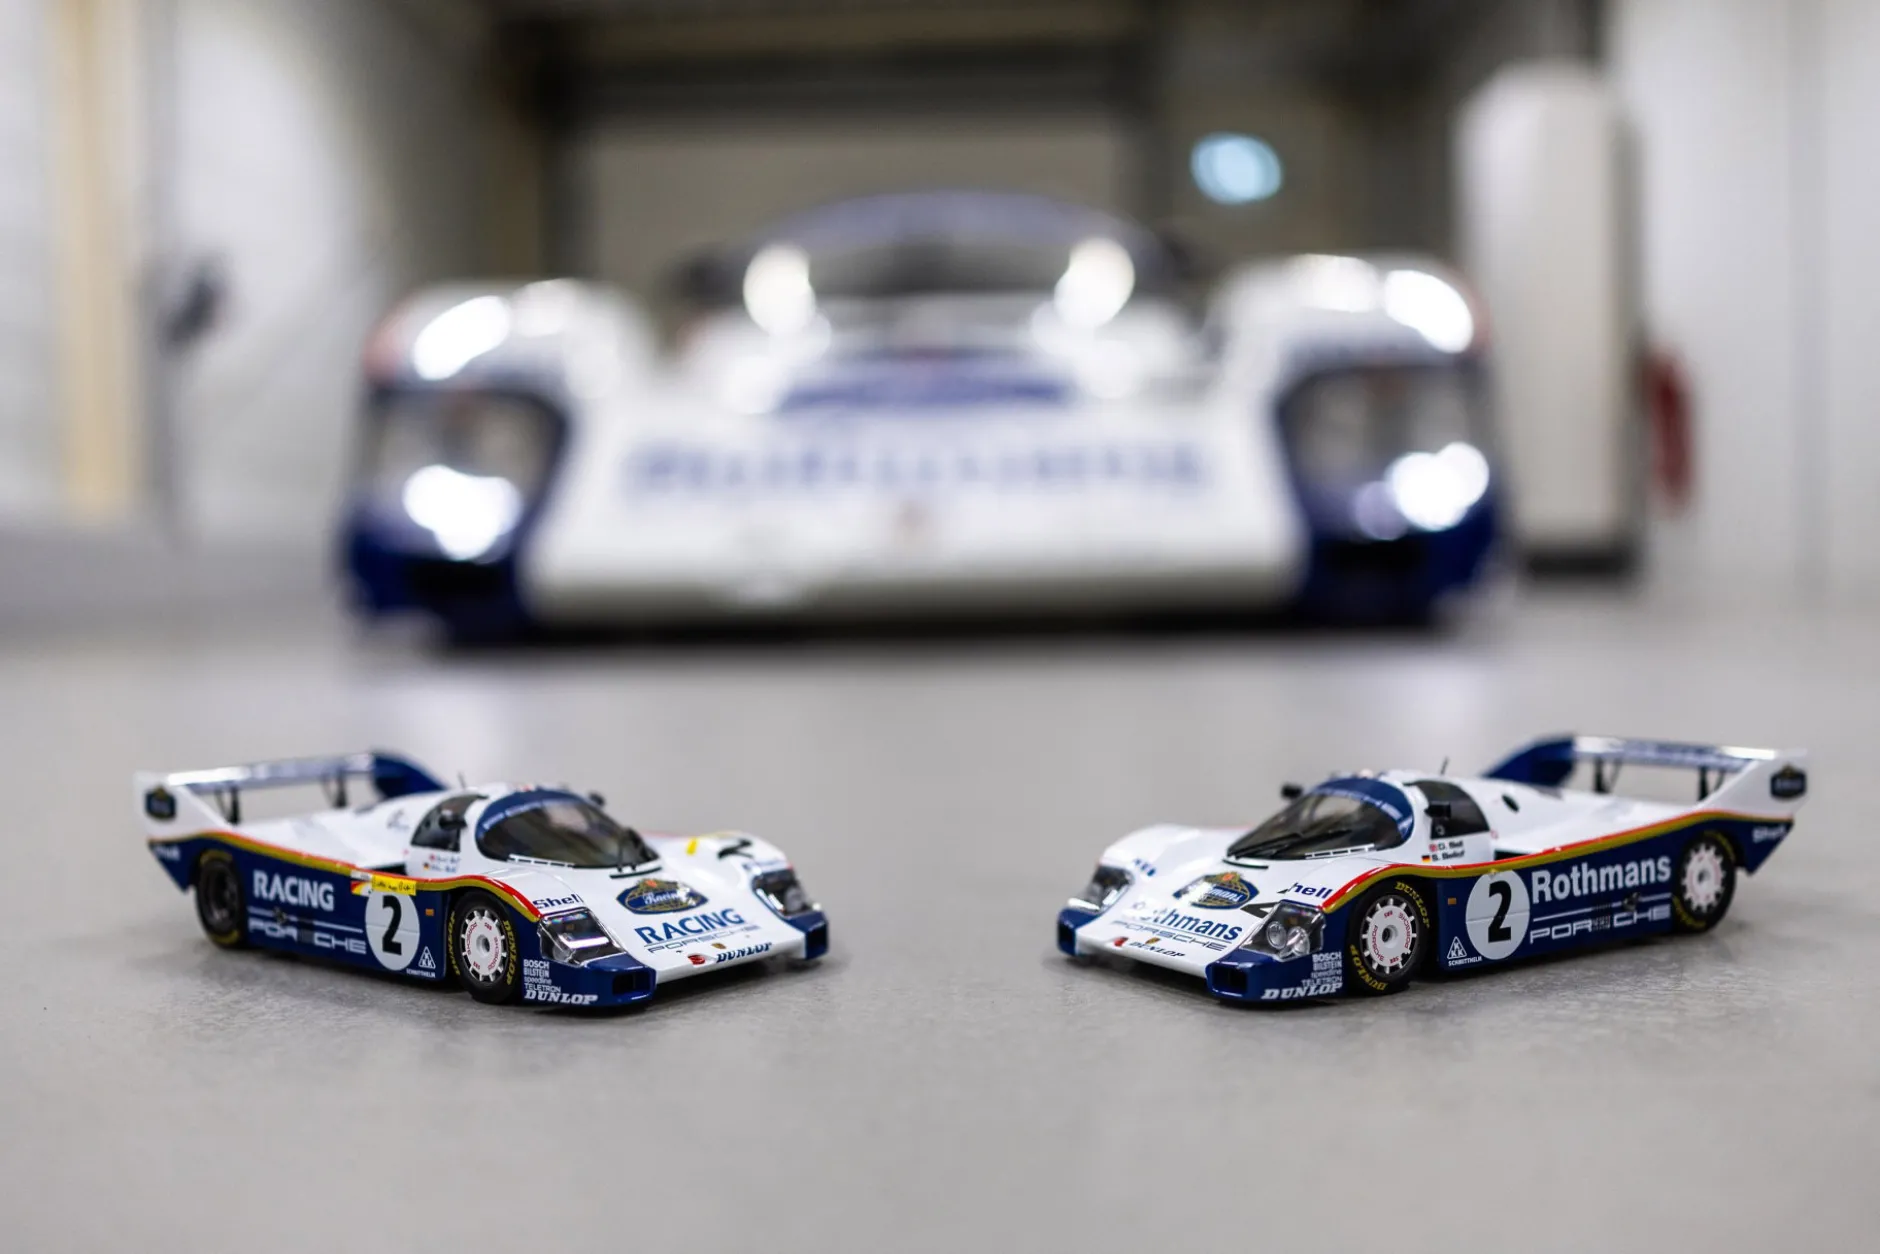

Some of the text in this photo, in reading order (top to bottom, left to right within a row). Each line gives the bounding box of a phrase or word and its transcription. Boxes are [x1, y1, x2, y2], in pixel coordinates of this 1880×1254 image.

[1531, 855, 1672, 904] Rothmans
[253, 869, 335, 912] RACING
[643, 890, 684, 905] Racin
[1287, 882, 1333, 899] hell
[1487, 880, 1512, 943] 2
[382, 895, 402, 956] 2
[634, 908, 745, 944] RACING
[1138, 906, 1242, 941] hmans
[247, 917, 367, 955] PORCHE
[647, 925, 760, 953] PORSCHE
[1111, 920, 1227, 951] PORSCHE
[716, 942, 773, 963] DUNLOP
[1312, 952, 1342, 963] BOSCH
[523, 959, 550, 969] BOSCH
[523, 967, 550, 978] BILSTEIN
[1313, 960, 1342, 971] BILSTEIN
[524, 983, 561, 993] TELETRON
[524, 990, 599, 1005] DUNLOP
[1261, 983, 1343, 999] DUNLOP
